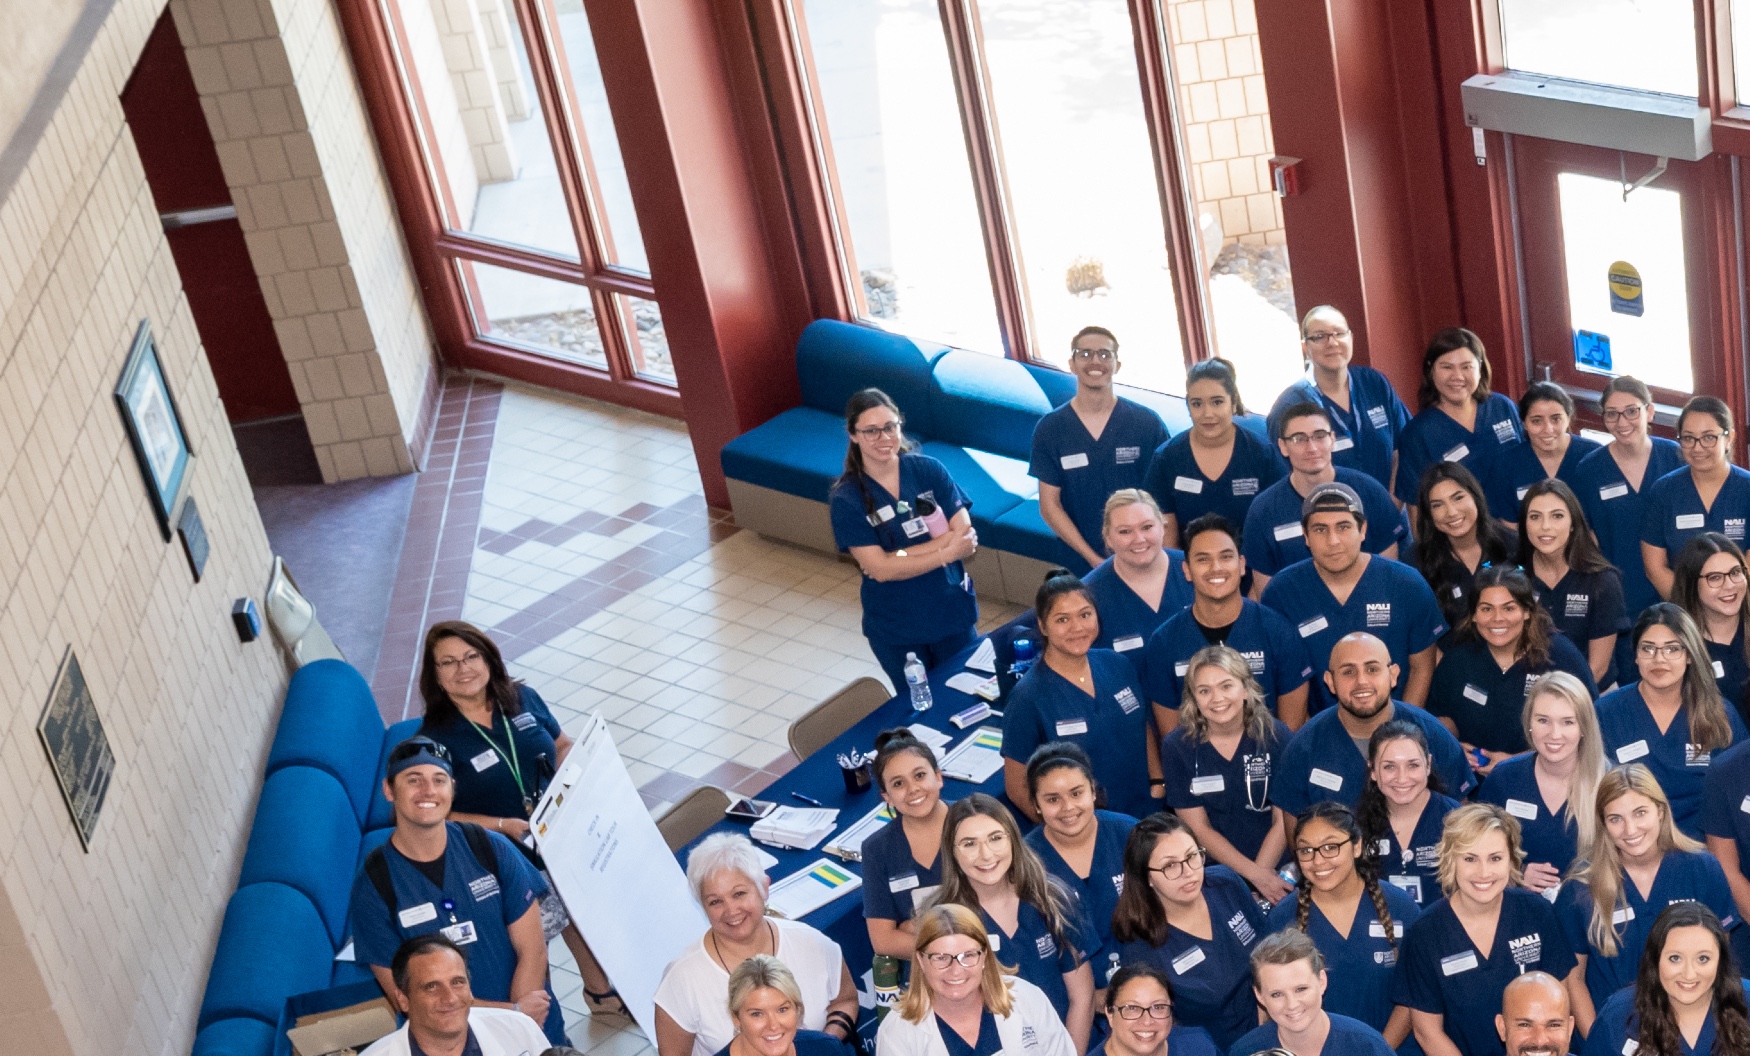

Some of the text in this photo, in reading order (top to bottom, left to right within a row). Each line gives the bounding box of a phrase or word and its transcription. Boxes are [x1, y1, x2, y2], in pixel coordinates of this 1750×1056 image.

[1228, 910, 1244, 929] NAU
[1508, 933, 1540, 949] NAU
[877, 993, 899, 1002] NA
